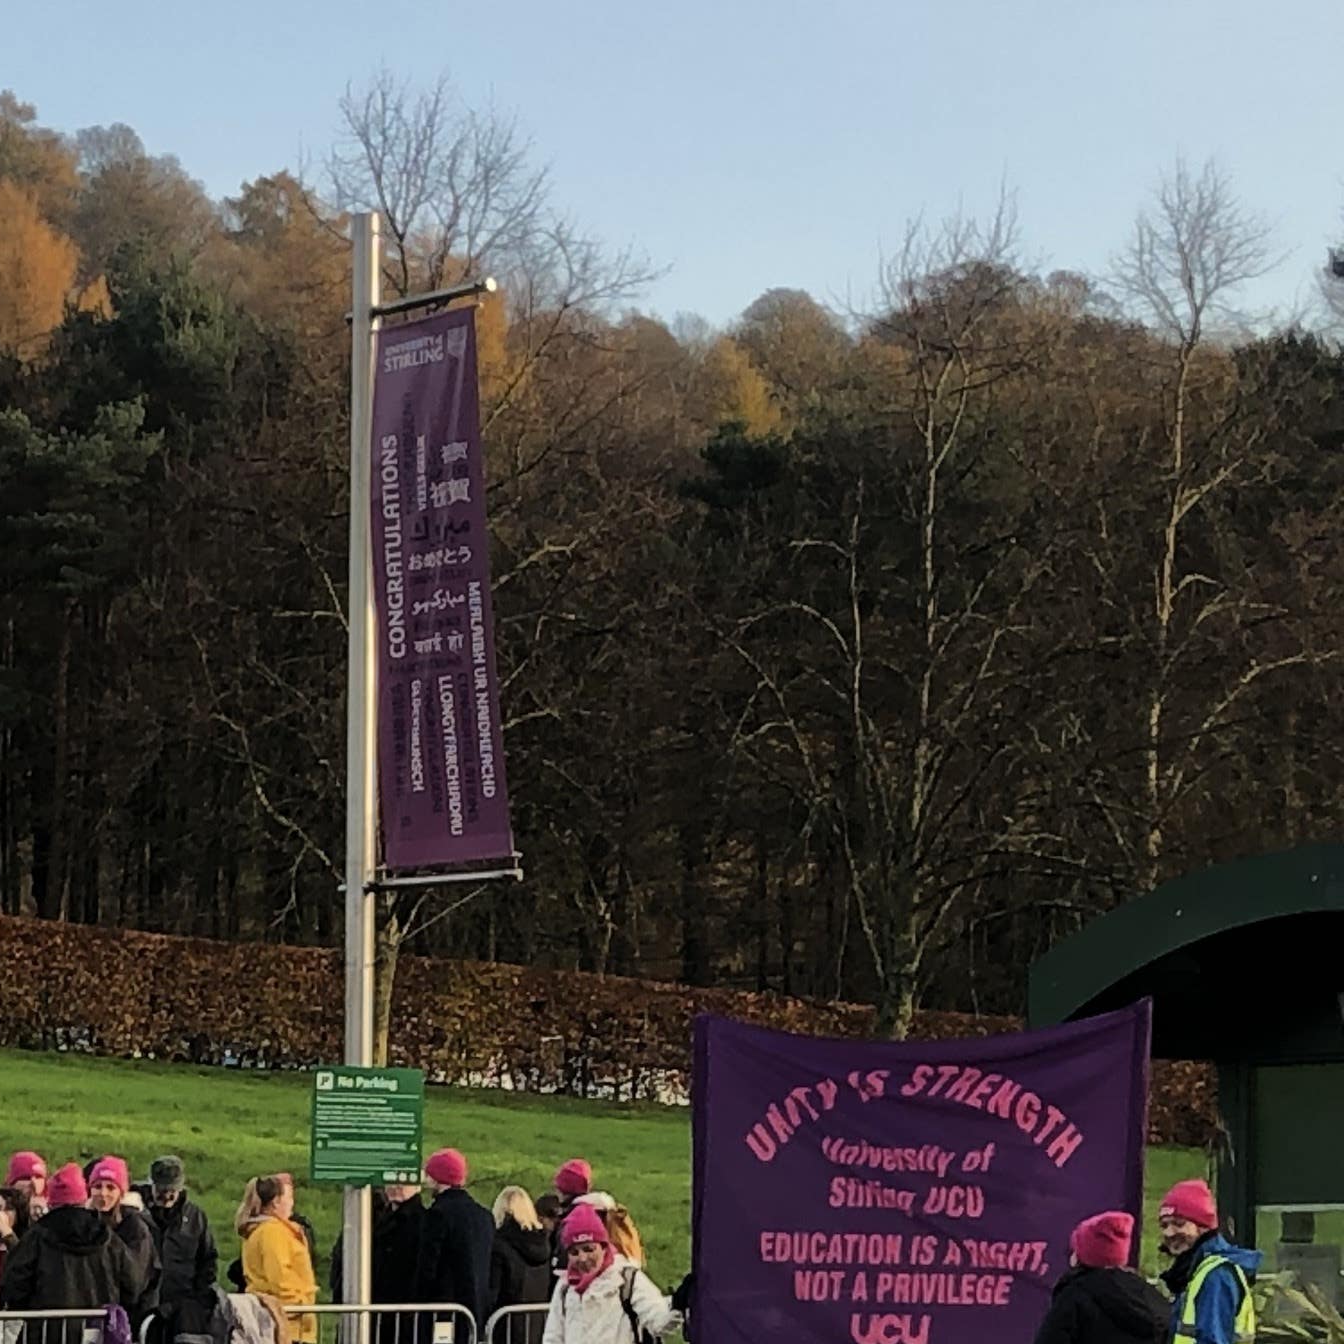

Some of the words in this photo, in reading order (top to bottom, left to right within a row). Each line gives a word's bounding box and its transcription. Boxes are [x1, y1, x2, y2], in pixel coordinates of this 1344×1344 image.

[384, 346, 444, 373] STIRLING
[381, 435, 406, 658] CONGRATULATIONS
[337, 1075, 354, 1088] No
[355, 1075, 399, 1092] Parking
[745, 1078, 838, 1162] UNITY
[847, 1070, 891, 1102] IS
[901, 1065, 1084, 1168] STRENGTH
[822, 1136, 955, 1178] University
[962, 1142, 996, 1172] of
[924, 1186, 984, 1218] UCU
[761, 1232, 902, 1265] EDUCATION
[910, 1235, 938, 1266] IS
[943, 1239, 962, 1267] A
[794, 1271, 845, 1301] NOT
[852, 1272, 868, 1301] A
[877, 1274, 1013, 1305] PRIVILEGE
